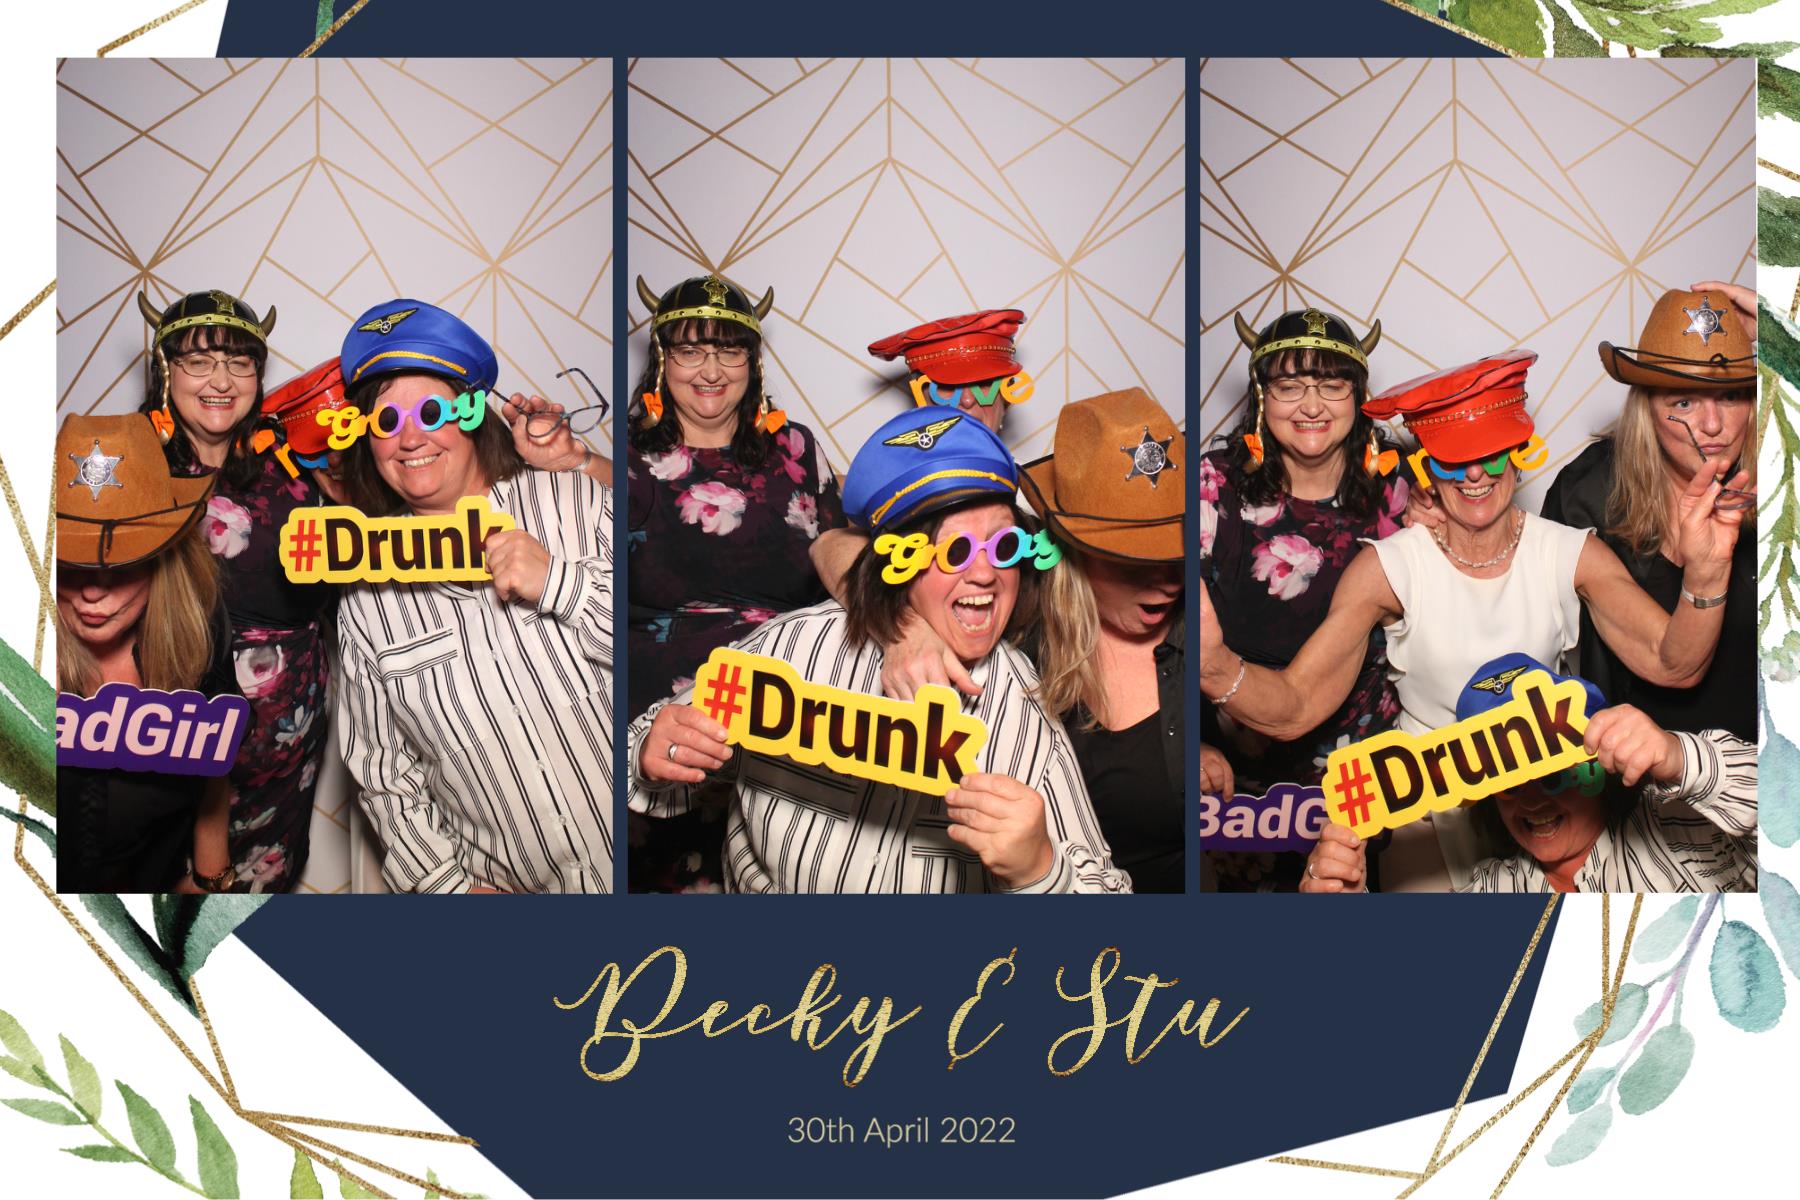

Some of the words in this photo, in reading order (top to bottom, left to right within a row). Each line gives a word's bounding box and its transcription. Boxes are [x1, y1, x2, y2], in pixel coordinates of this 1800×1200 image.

[289, 509, 505, 571] #Drunk
[703, 663, 970, 784] #Drunk
[1334, 687, 1585, 827] #Drunk
